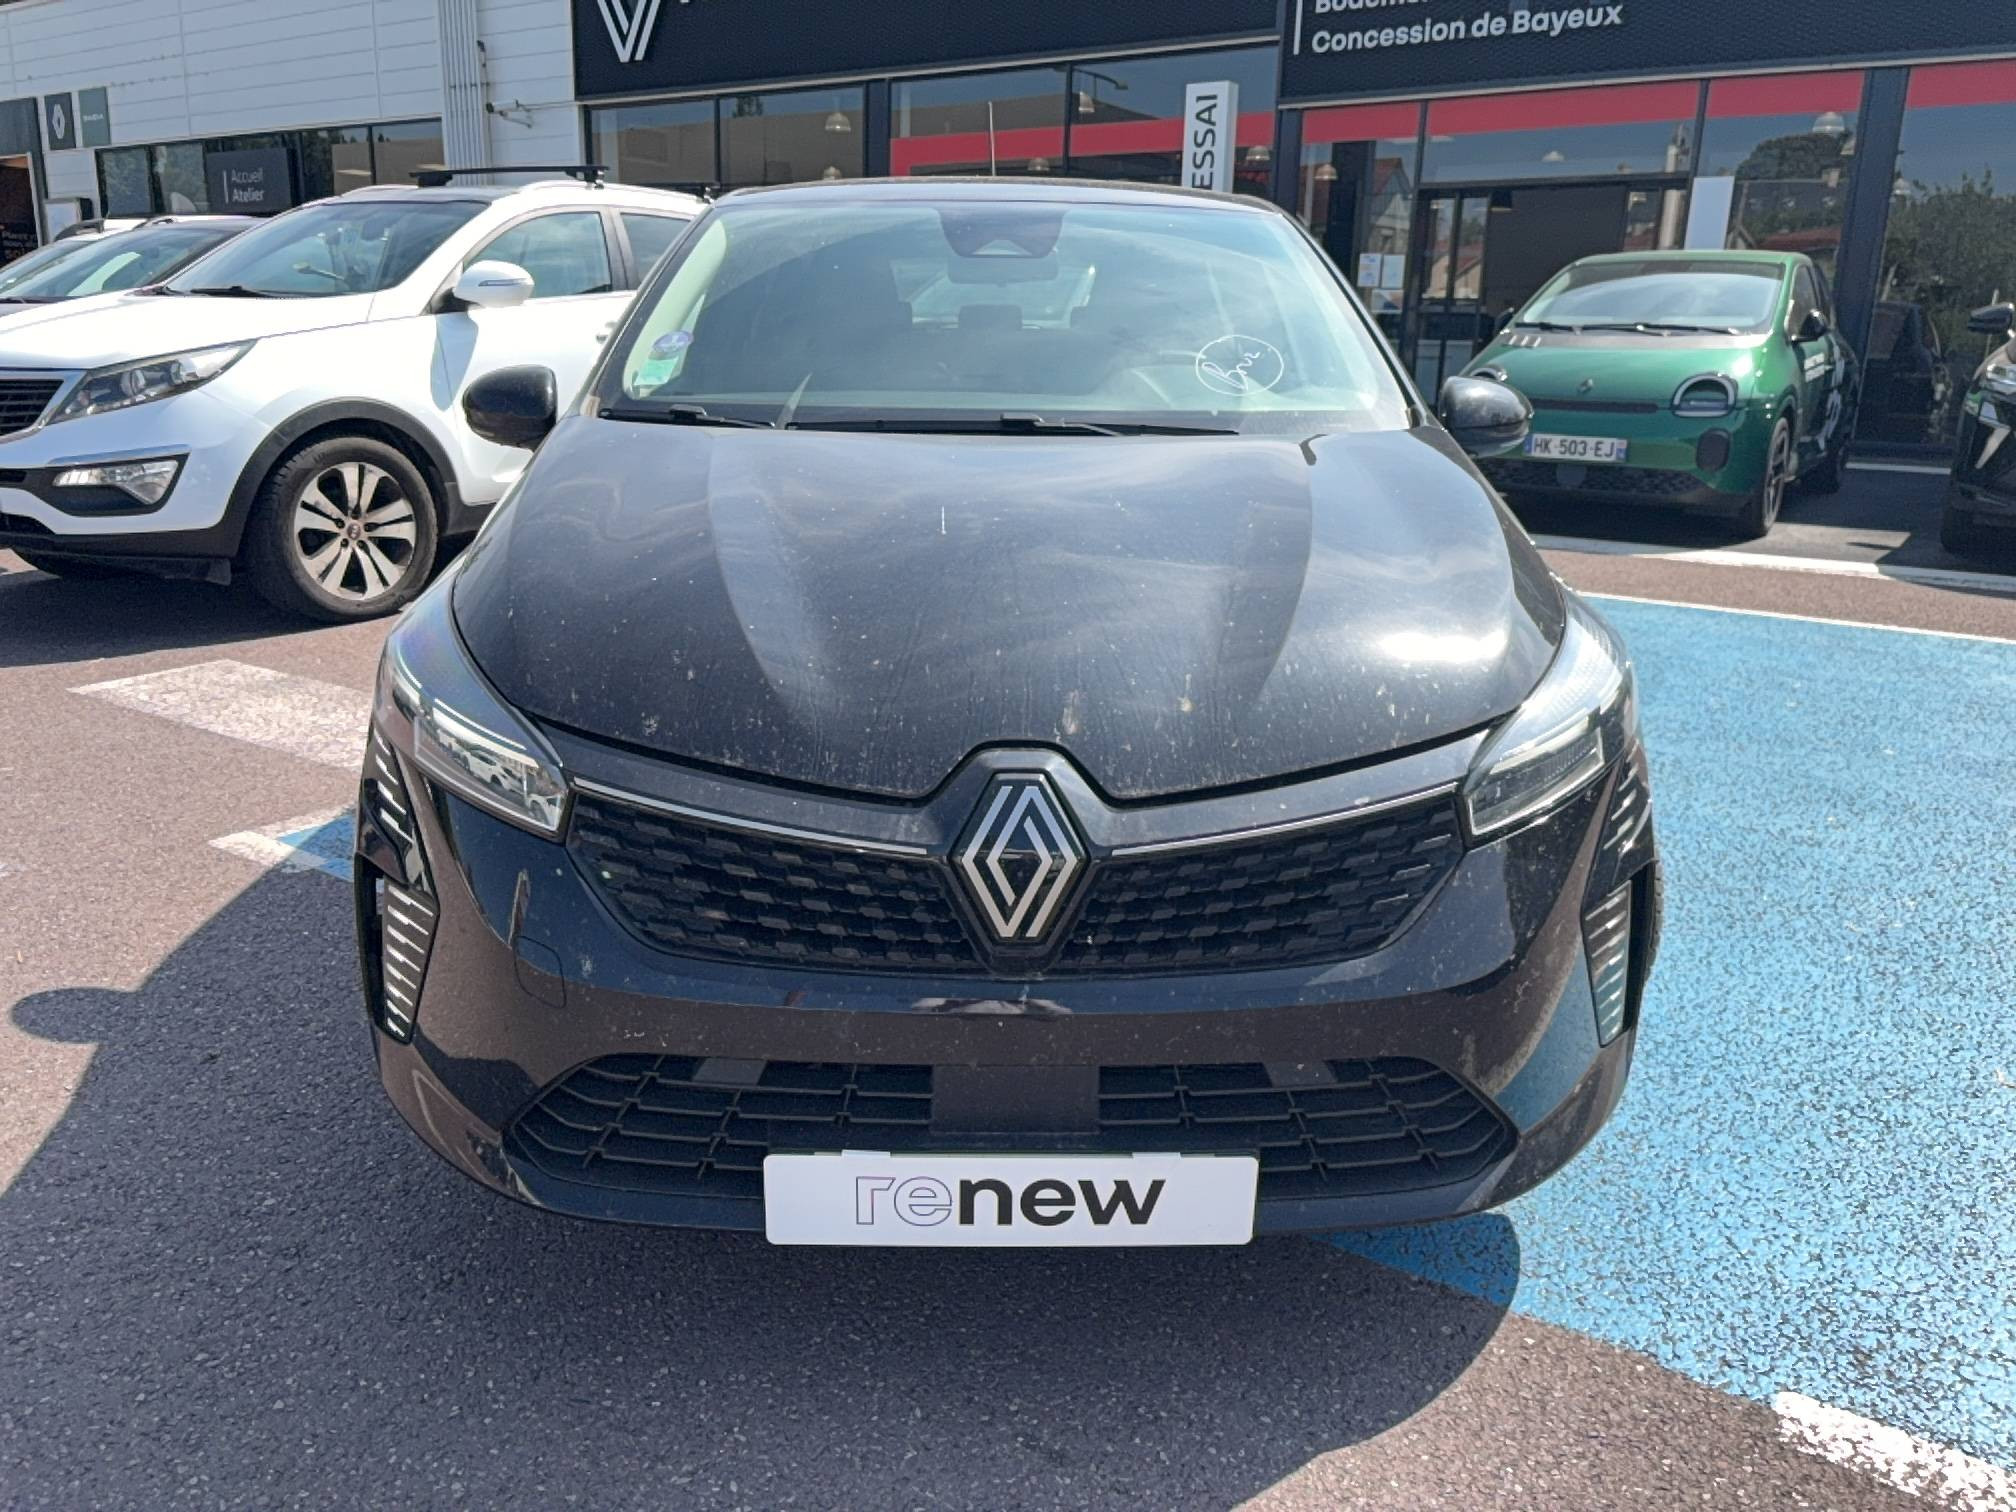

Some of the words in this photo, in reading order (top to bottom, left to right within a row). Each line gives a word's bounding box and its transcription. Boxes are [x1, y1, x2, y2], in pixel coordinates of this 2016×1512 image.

[1311, 17, 1466, 53] Concession
[1471, 11, 1507, 38] de
[1511, 5, 1624, 37] Bayeux
[1191, 94, 1218, 190] ESSAI
[232, 187, 265, 202] Atelier
[855, 1176, 1167, 1227] renew
